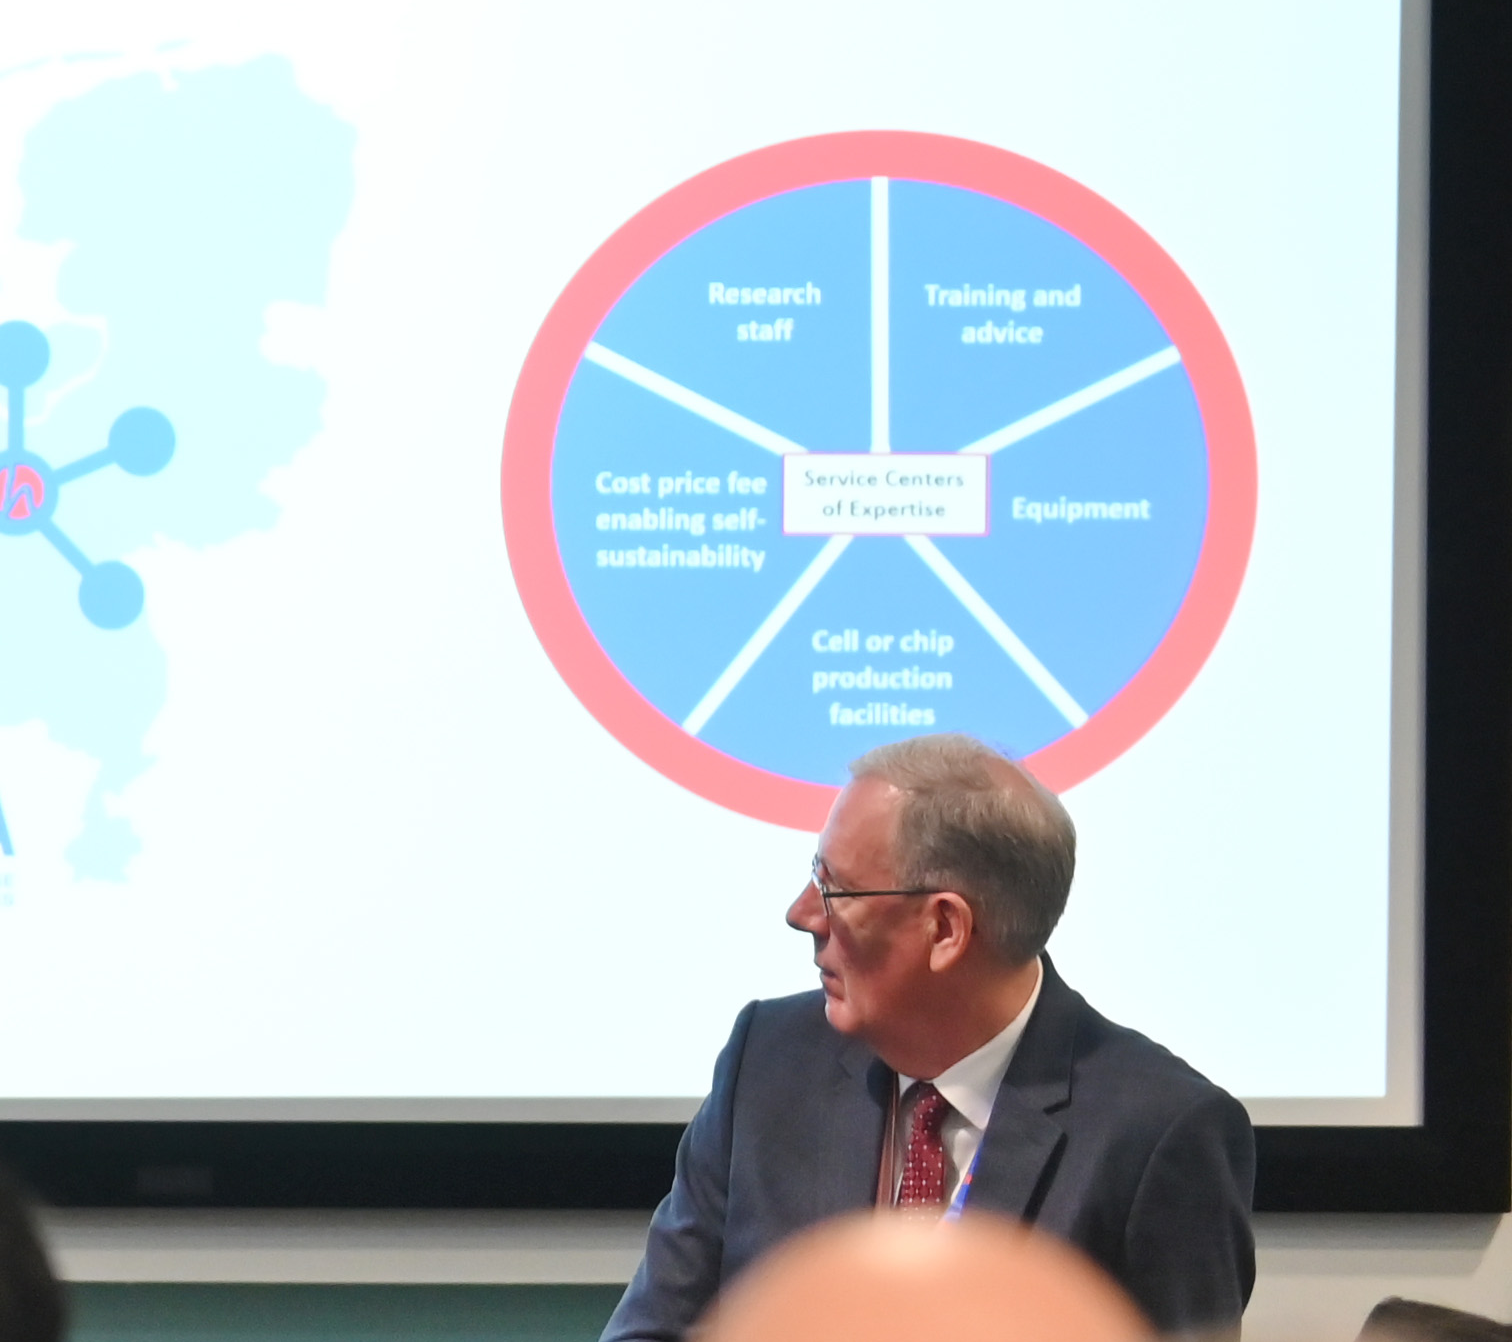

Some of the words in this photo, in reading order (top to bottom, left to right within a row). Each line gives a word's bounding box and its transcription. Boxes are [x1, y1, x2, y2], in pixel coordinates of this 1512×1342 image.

[708, 281, 822, 305] Research
[924, 283, 1027, 311] Training
[1033, 284, 1082, 307] and
[737, 318, 795, 341] staff
[961, 320, 1044, 344] advice
[595, 471, 651, 494] Cost
[658, 470, 720, 499] price
[727, 471, 768, 494] fee
[804, 470, 878, 487] Service
[885, 469, 964, 487] Centers
[595, 508, 706, 535] enabling
[713, 508, 768, 531] self-
[822, 499, 843, 517] of
[850, 499, 946, 520] Expertise
[1012, 496, 1152, 523] Equipment
[596, 544, 766, 573] sustainability
[812, 629, 859, 652] Cell
[866, 634, 894, 652] or
[900, 629, 955, 657] chip
[812, 665, 953, 694] production
[829, 701, 936, 726] facilities
